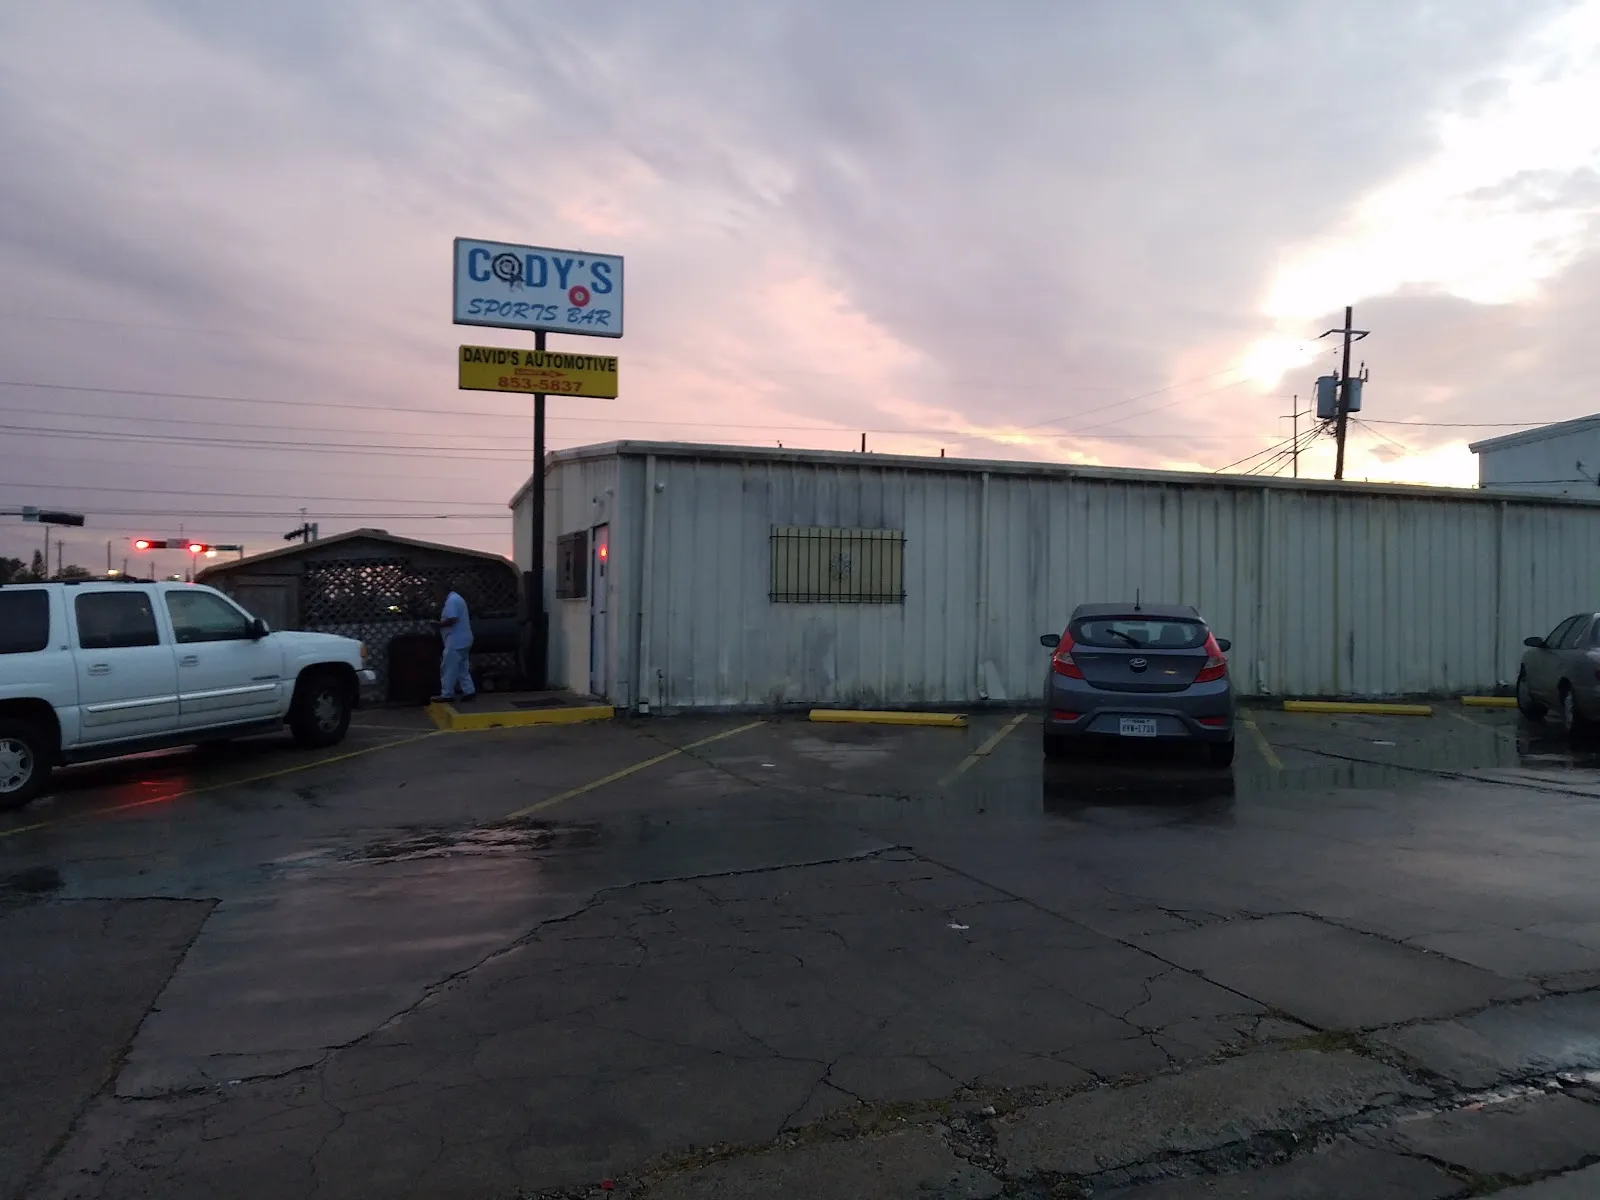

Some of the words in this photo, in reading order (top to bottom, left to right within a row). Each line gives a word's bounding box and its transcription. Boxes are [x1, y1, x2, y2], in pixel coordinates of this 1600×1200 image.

[468, 248, 613, 294] CODY'S
[468, 298, 559, 321] SPORTS
[566, 308, 612, 326] BAR
[463, 348, 519, 366] DAVID'S
[525, 351, 617, 372] AUTOMOTIVE
[498, 376, 583, 392] 853-5837
